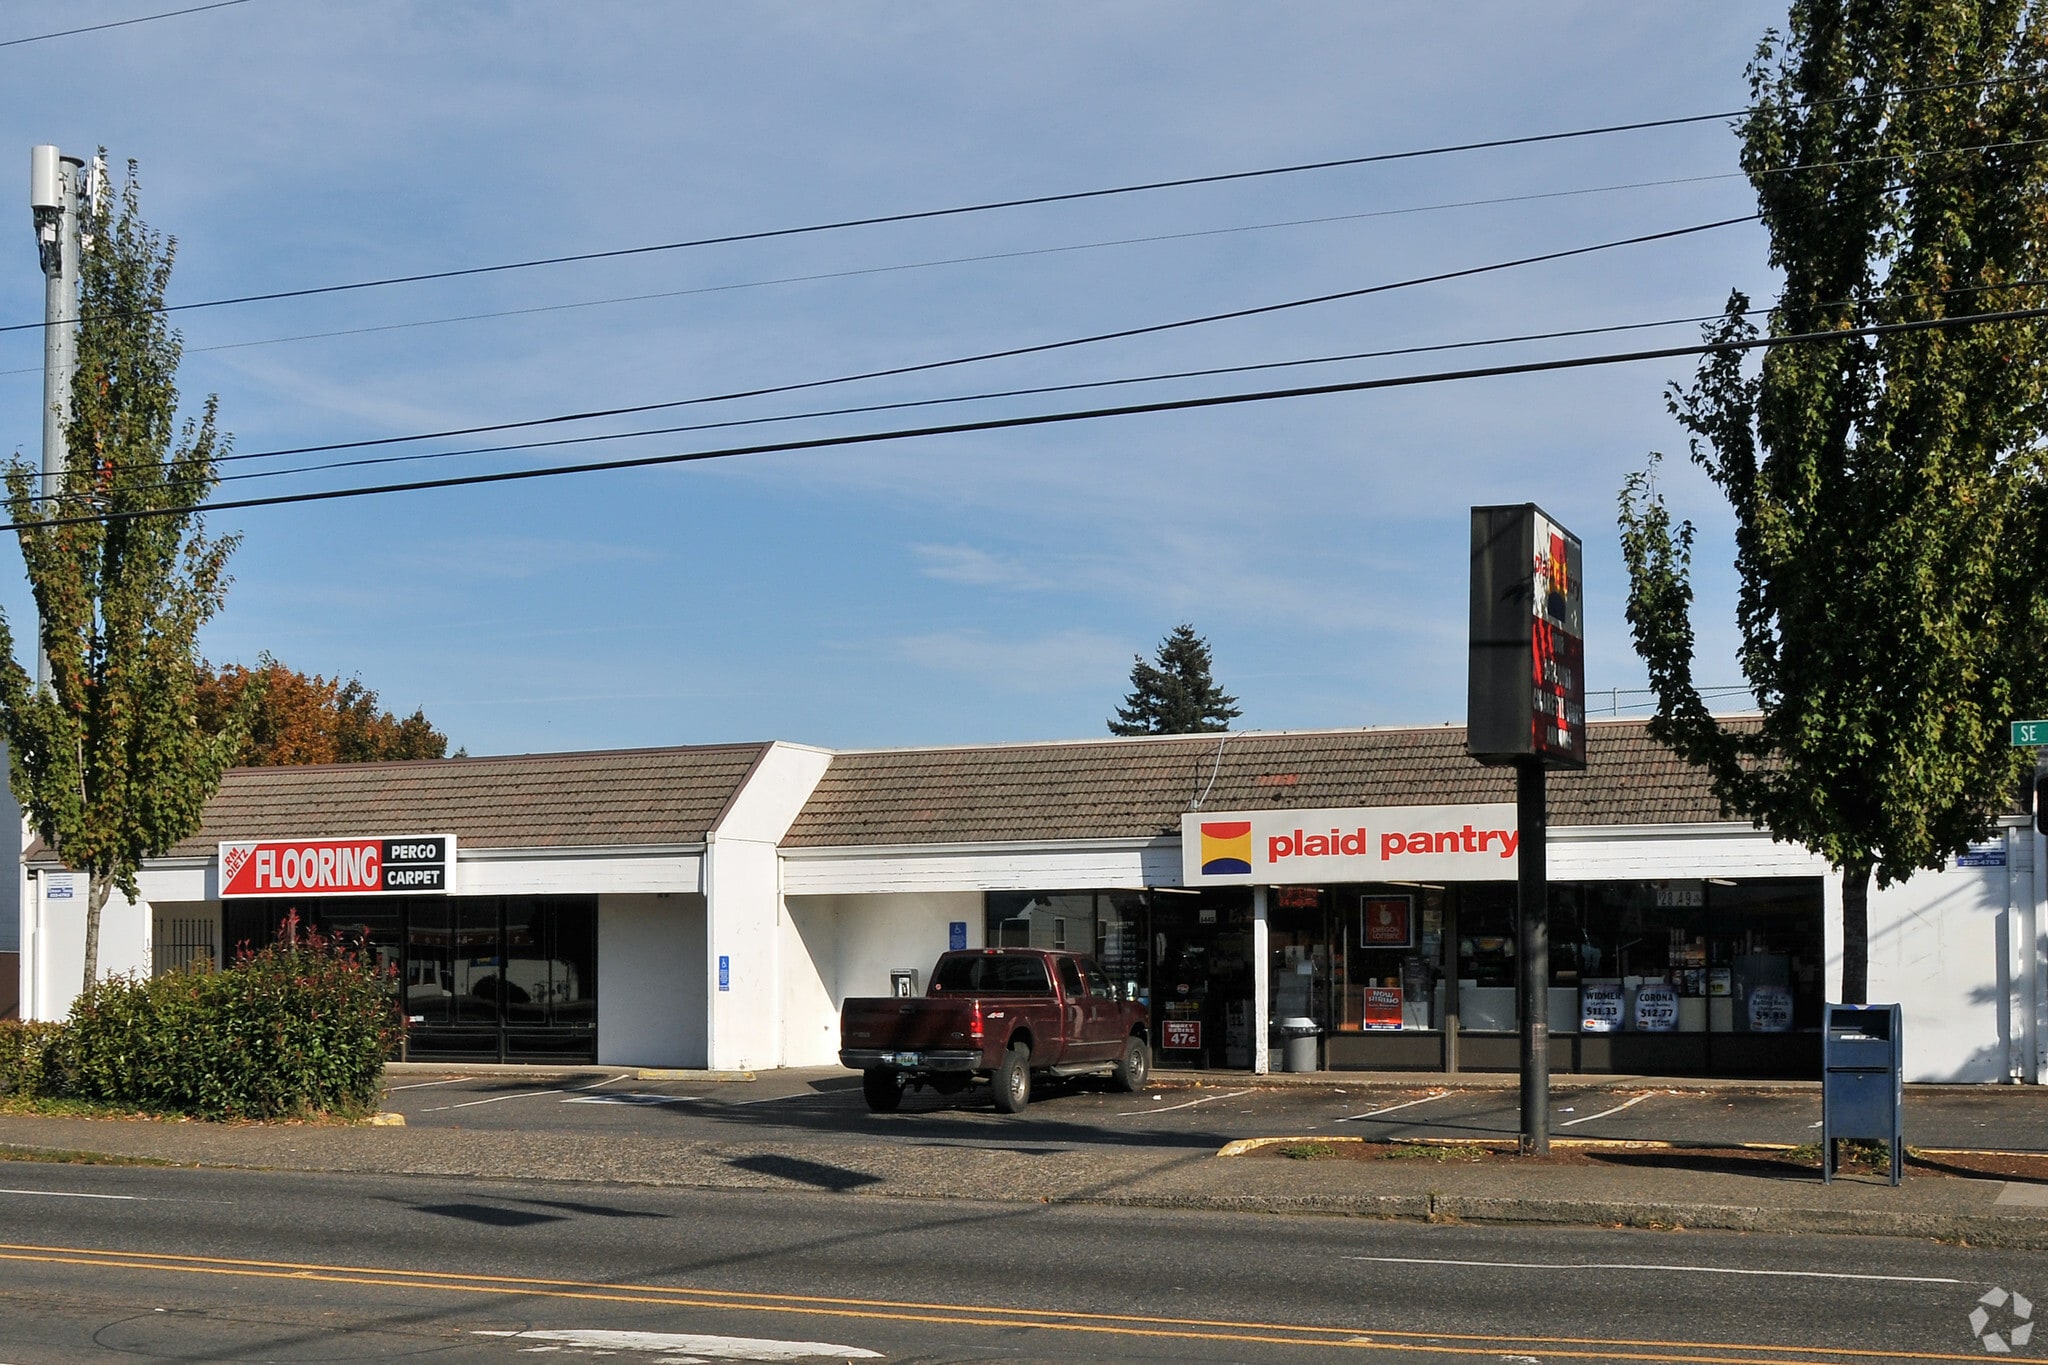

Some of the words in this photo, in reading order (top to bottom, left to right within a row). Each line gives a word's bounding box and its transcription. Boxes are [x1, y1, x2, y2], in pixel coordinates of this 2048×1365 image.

[2021, 725, 2037, 741] SE
[1268, 827, 1366, 863] plaid
[1380, 824, 1519, 861] pantry
[224, 847, 240, 866] RM
[391, 844, 437, 859] PERGO
[225, 848, 249, 879] DIETZ
[255, 845, 379, 888] FLOORING
[387, 870, 440, 885] CARPET
[1586, 991, 1622, 1000] WIDMER
[1639, 993, 1674, 1002] CORONA
[1586, 1006, 1617, 1015] $11.33
[1640, 1008, 1674, 1017] $12.77
